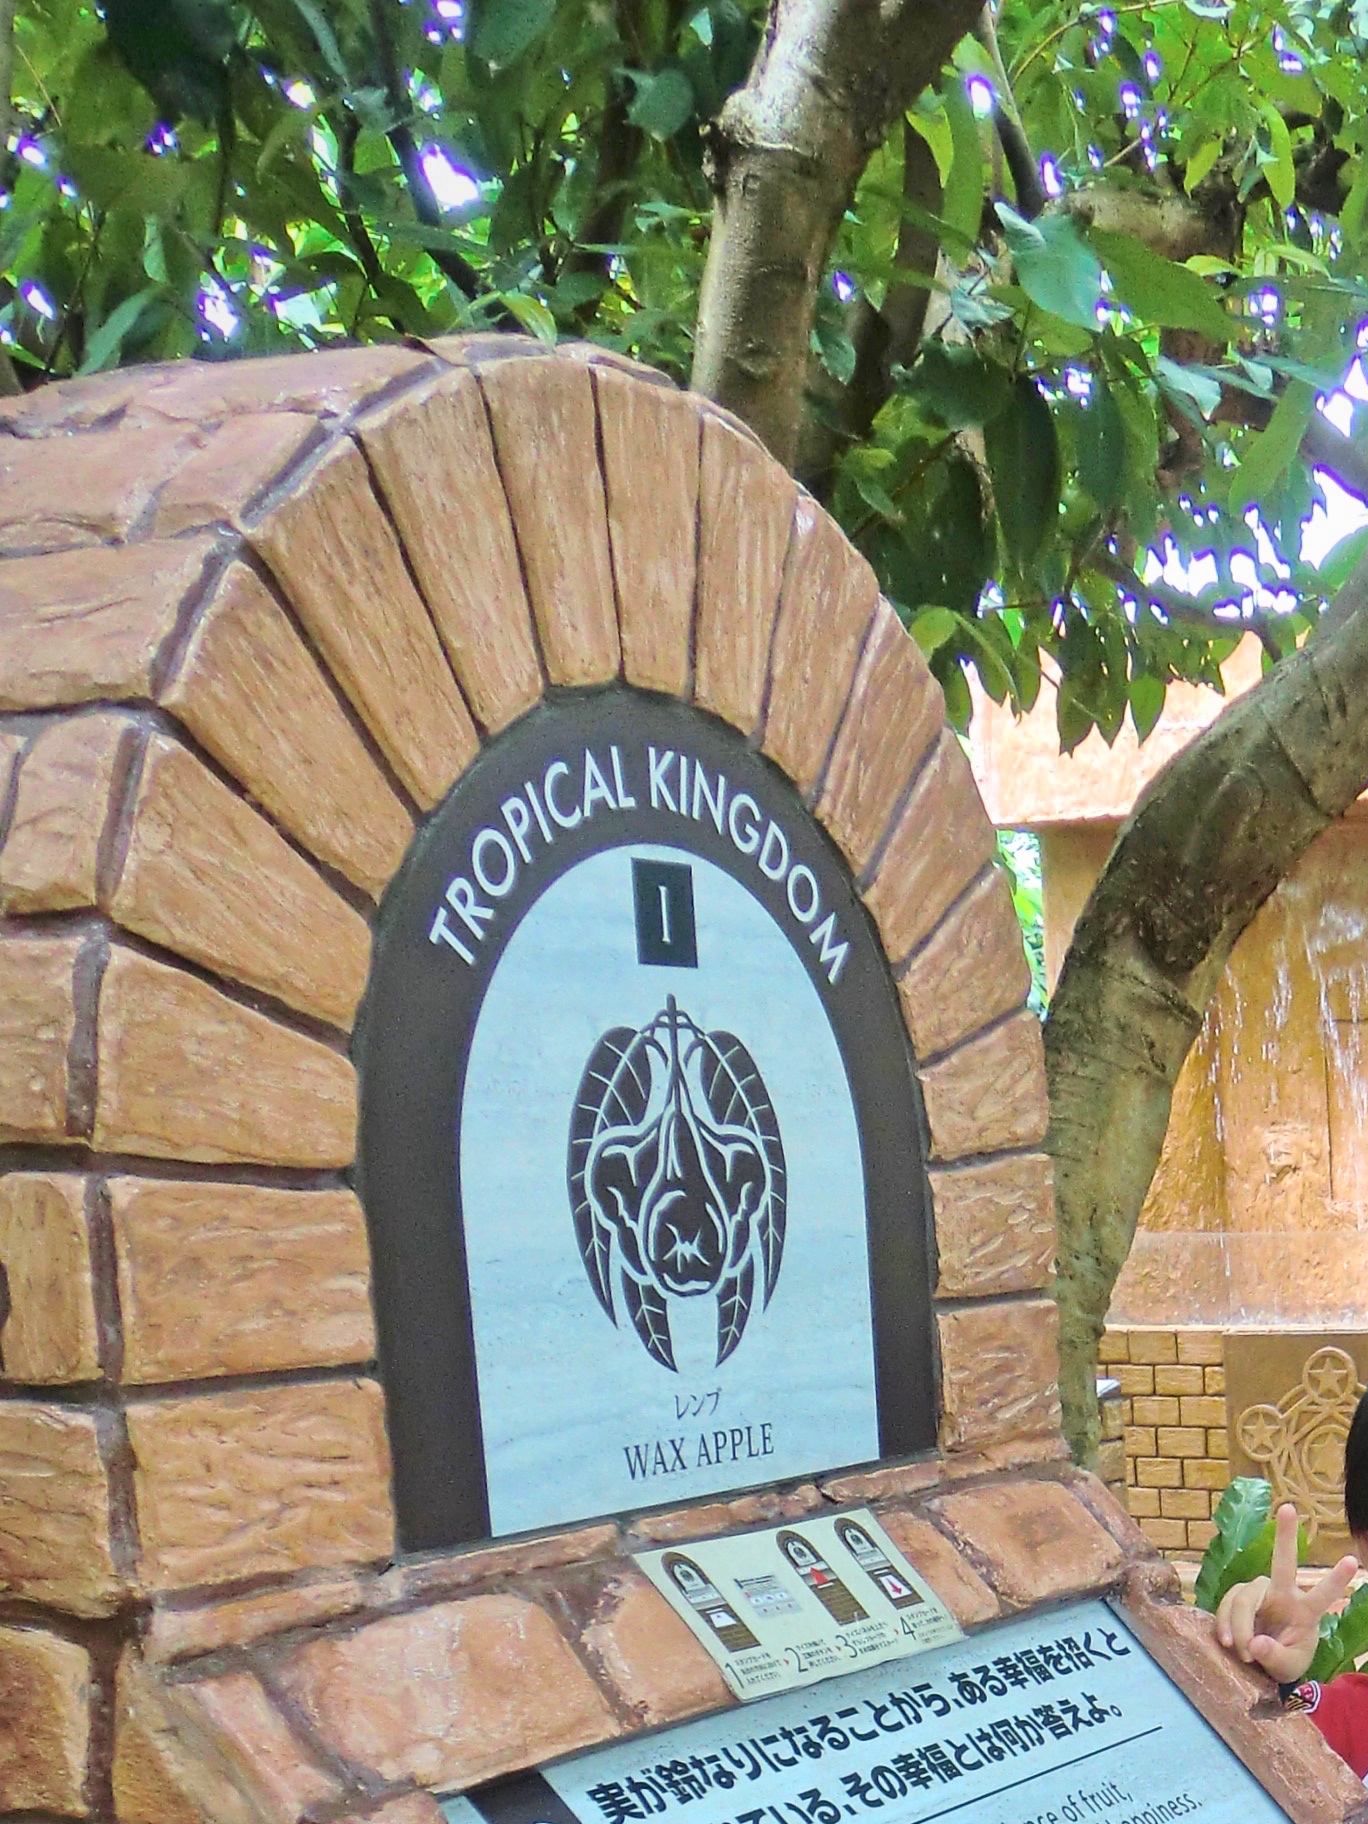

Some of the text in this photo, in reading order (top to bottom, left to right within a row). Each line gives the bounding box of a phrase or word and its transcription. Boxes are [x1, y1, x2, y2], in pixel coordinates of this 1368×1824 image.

[429, 745, 849, 985] TROPICAL KINGDOM
[623, 1422, 774, 1480] WAX APPLE
[1062, 1795, 1086, 1822] of
[1078, 1782, 1134, 1815] fruit,
